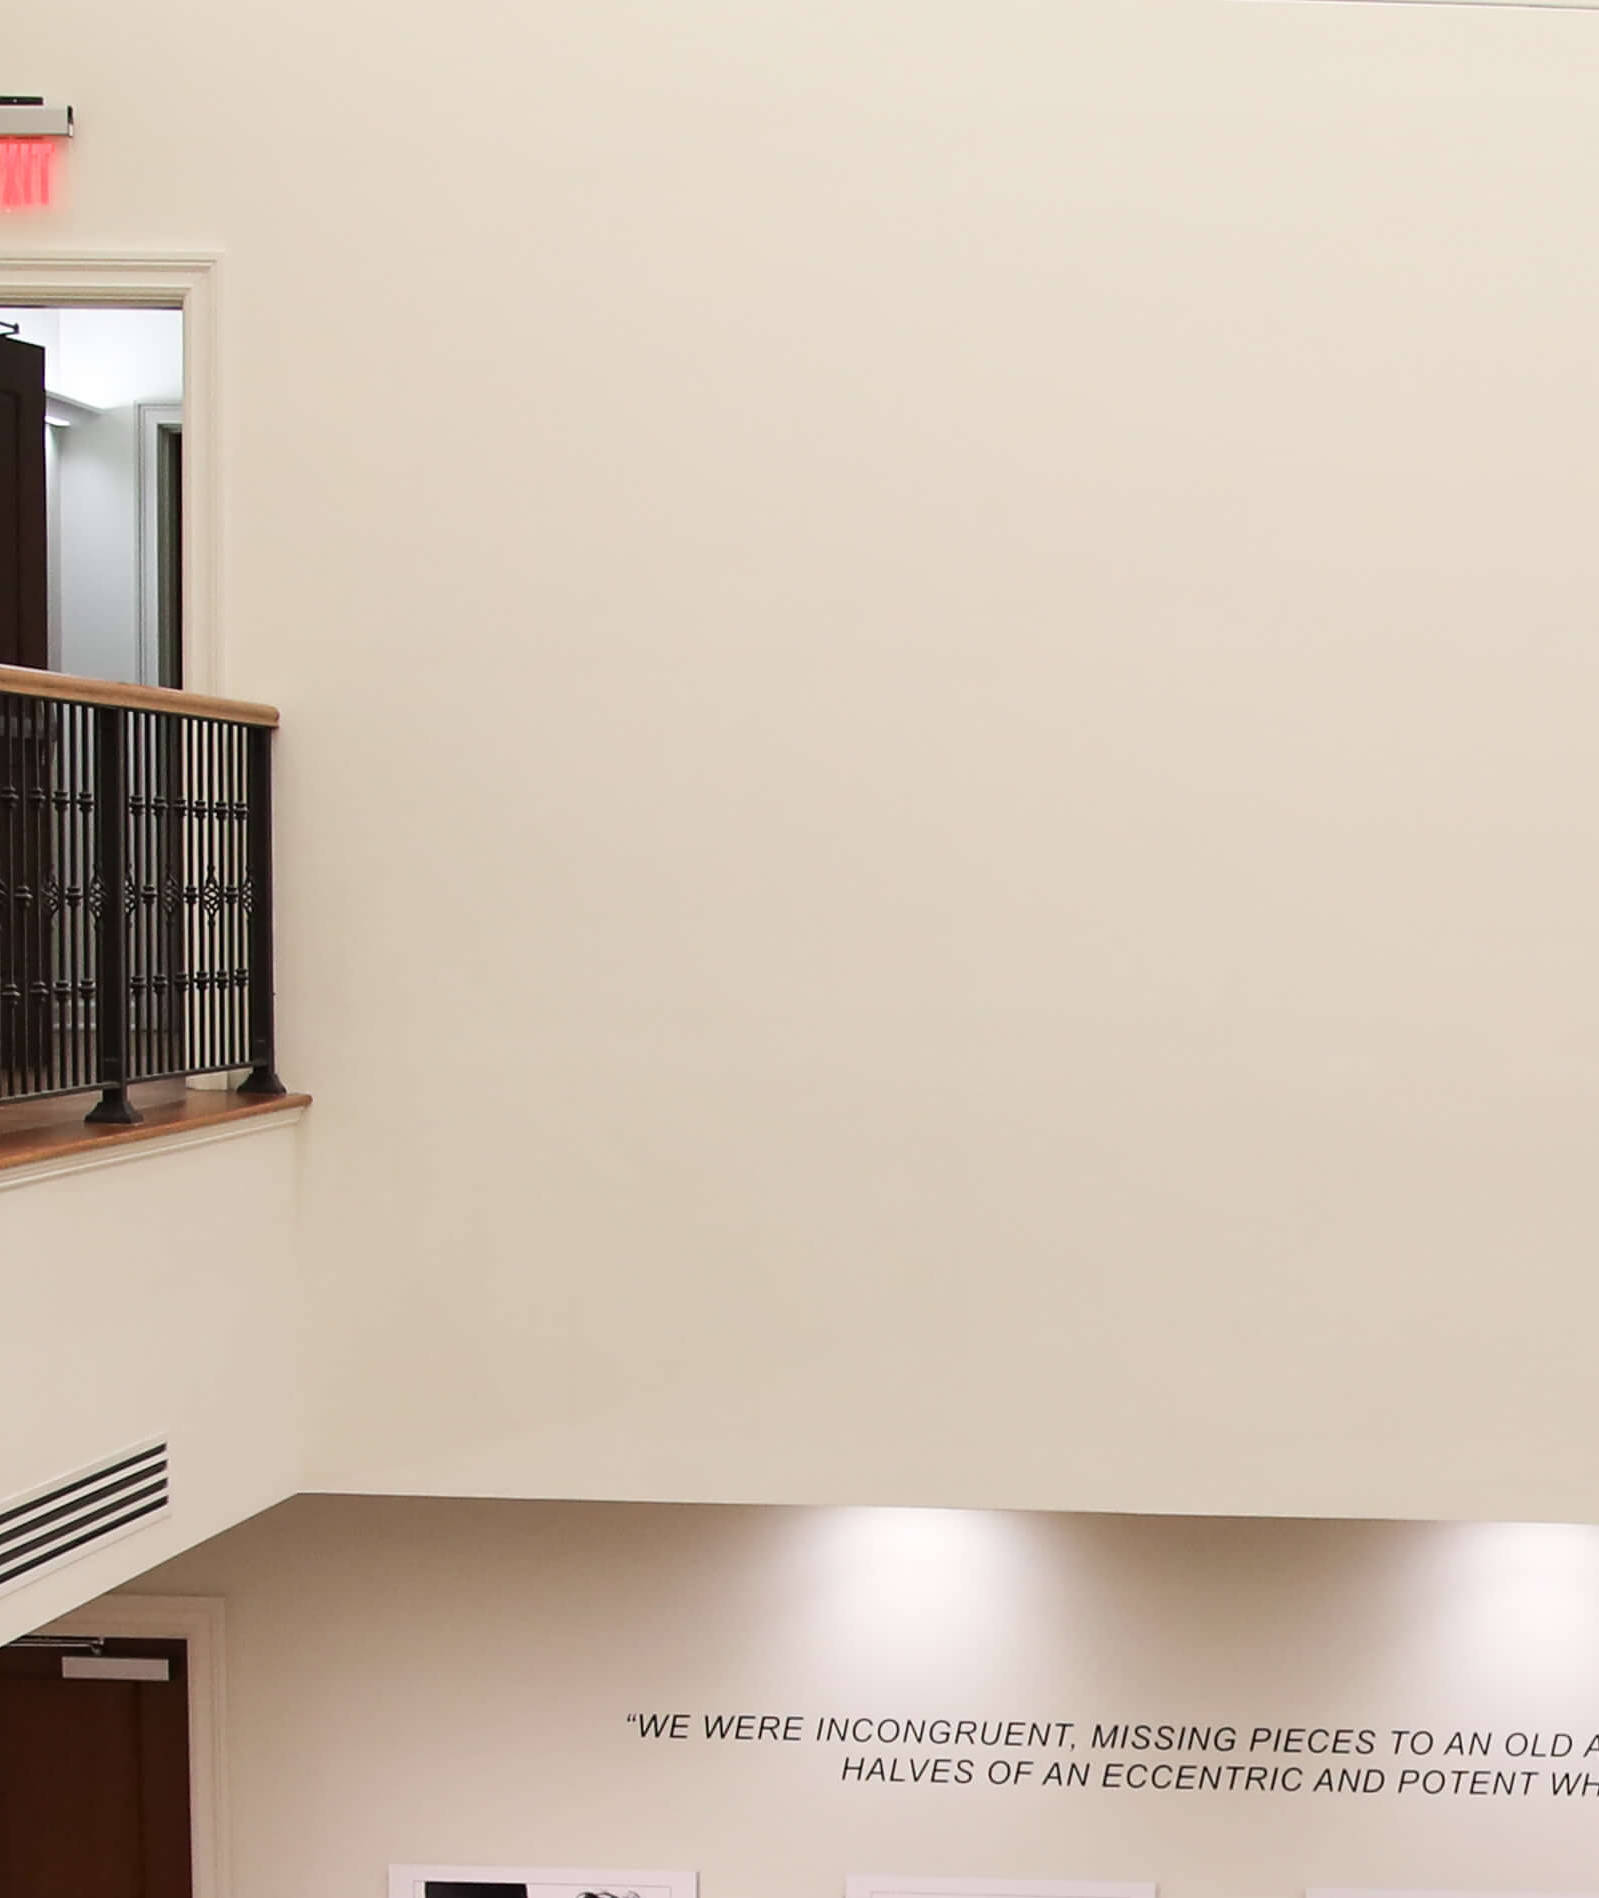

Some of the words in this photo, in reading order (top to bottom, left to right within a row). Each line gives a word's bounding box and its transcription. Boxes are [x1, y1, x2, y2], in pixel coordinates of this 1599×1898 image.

[626, 1712, 692, 1740] “WE
[704, 1714, 805, 1742] WERE
[816, 1716, 1076, 1751] INCONGRUENT,
[1091, 1723, 1237, 1753] MISSING
[1249, 1727, 1377, 1755] PIECES
[1390, 1729, 1434, 1756] TO
[1442, 1731, 1493, 1757] AN
[1504, 1731, 1574, 1758] OLD
[841, 1756, 975, 1785] HALVES
[987, 1759, 1034, 1786] OF
[1040, 1761, 1091, 1788] AN
[1101, 1762, 1304, 1793] ECCENTRIC
[1312, 1767, 1386, 1794] AND
[1397, 1769, 1540, 1797] POTENT
